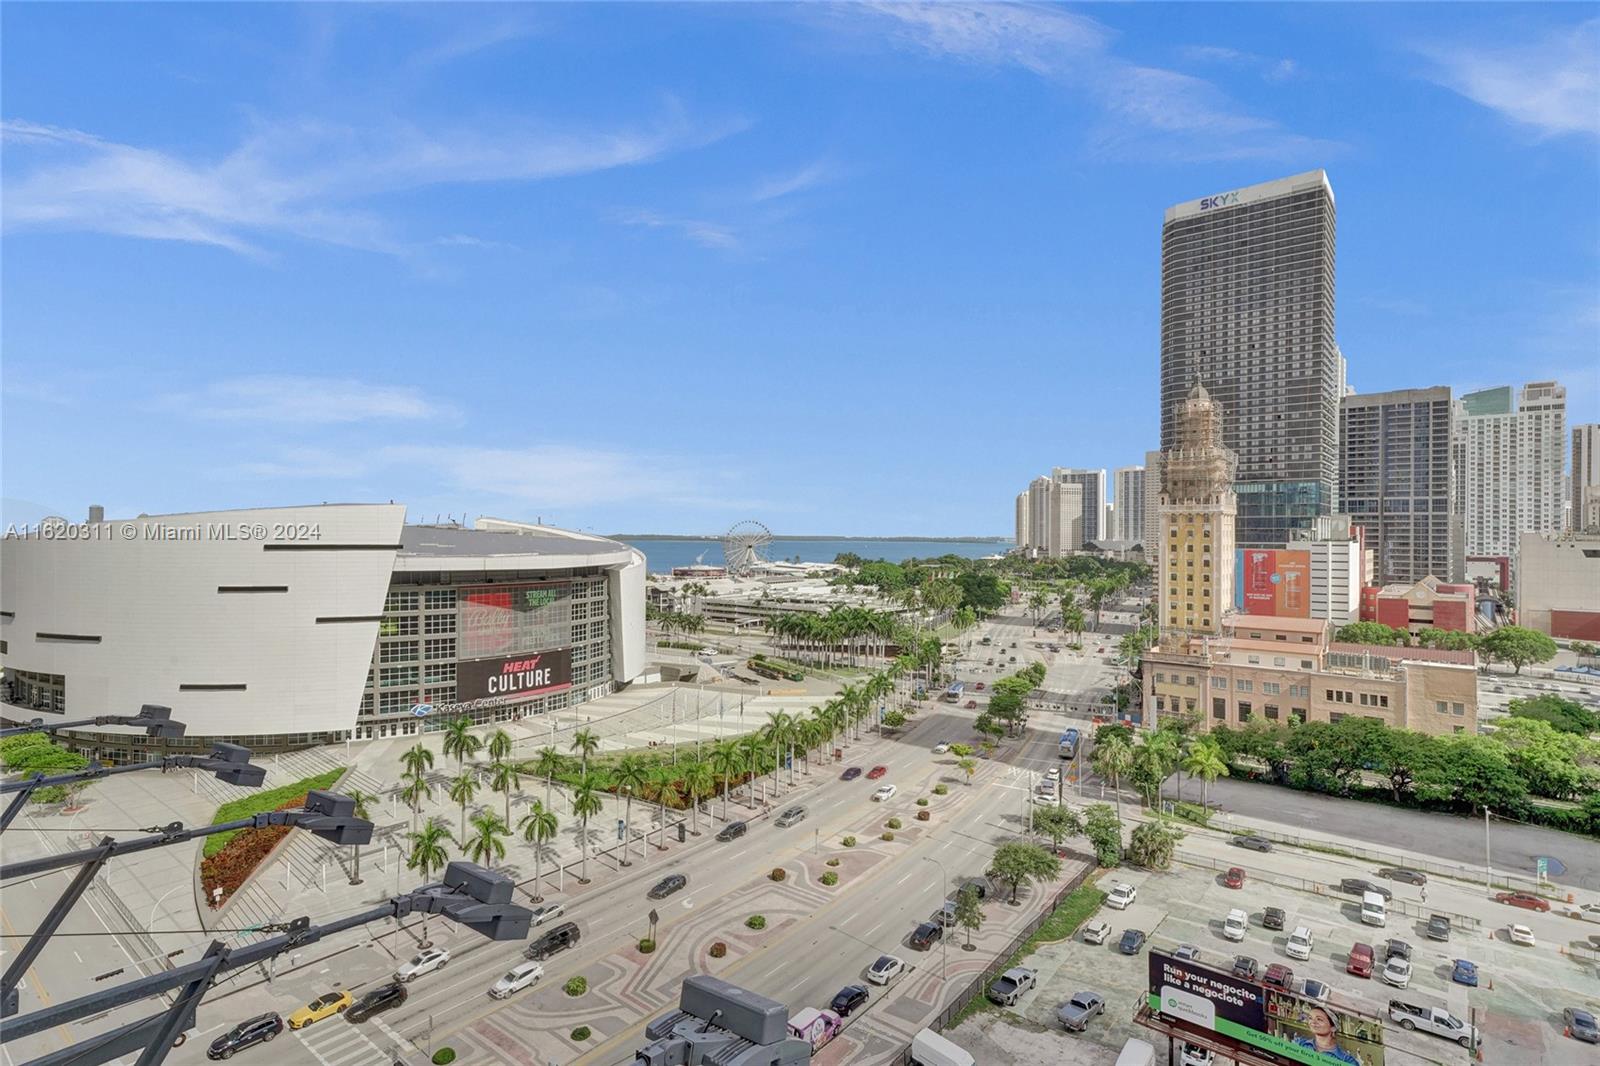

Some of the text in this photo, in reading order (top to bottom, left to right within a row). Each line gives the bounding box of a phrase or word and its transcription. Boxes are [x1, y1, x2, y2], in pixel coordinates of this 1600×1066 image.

[1200, 191, 1239, 211] SKYX
[503, 655, 541, 673] HEAT
[488, 668, 552, 694] CULTURE
[436, 702, 472, 713] Kaseya
[1163, 973, 1182, 986] like
[1183, 981, 1190, 989] a
[1163, 963, 1257, 1001] Run your negocito
